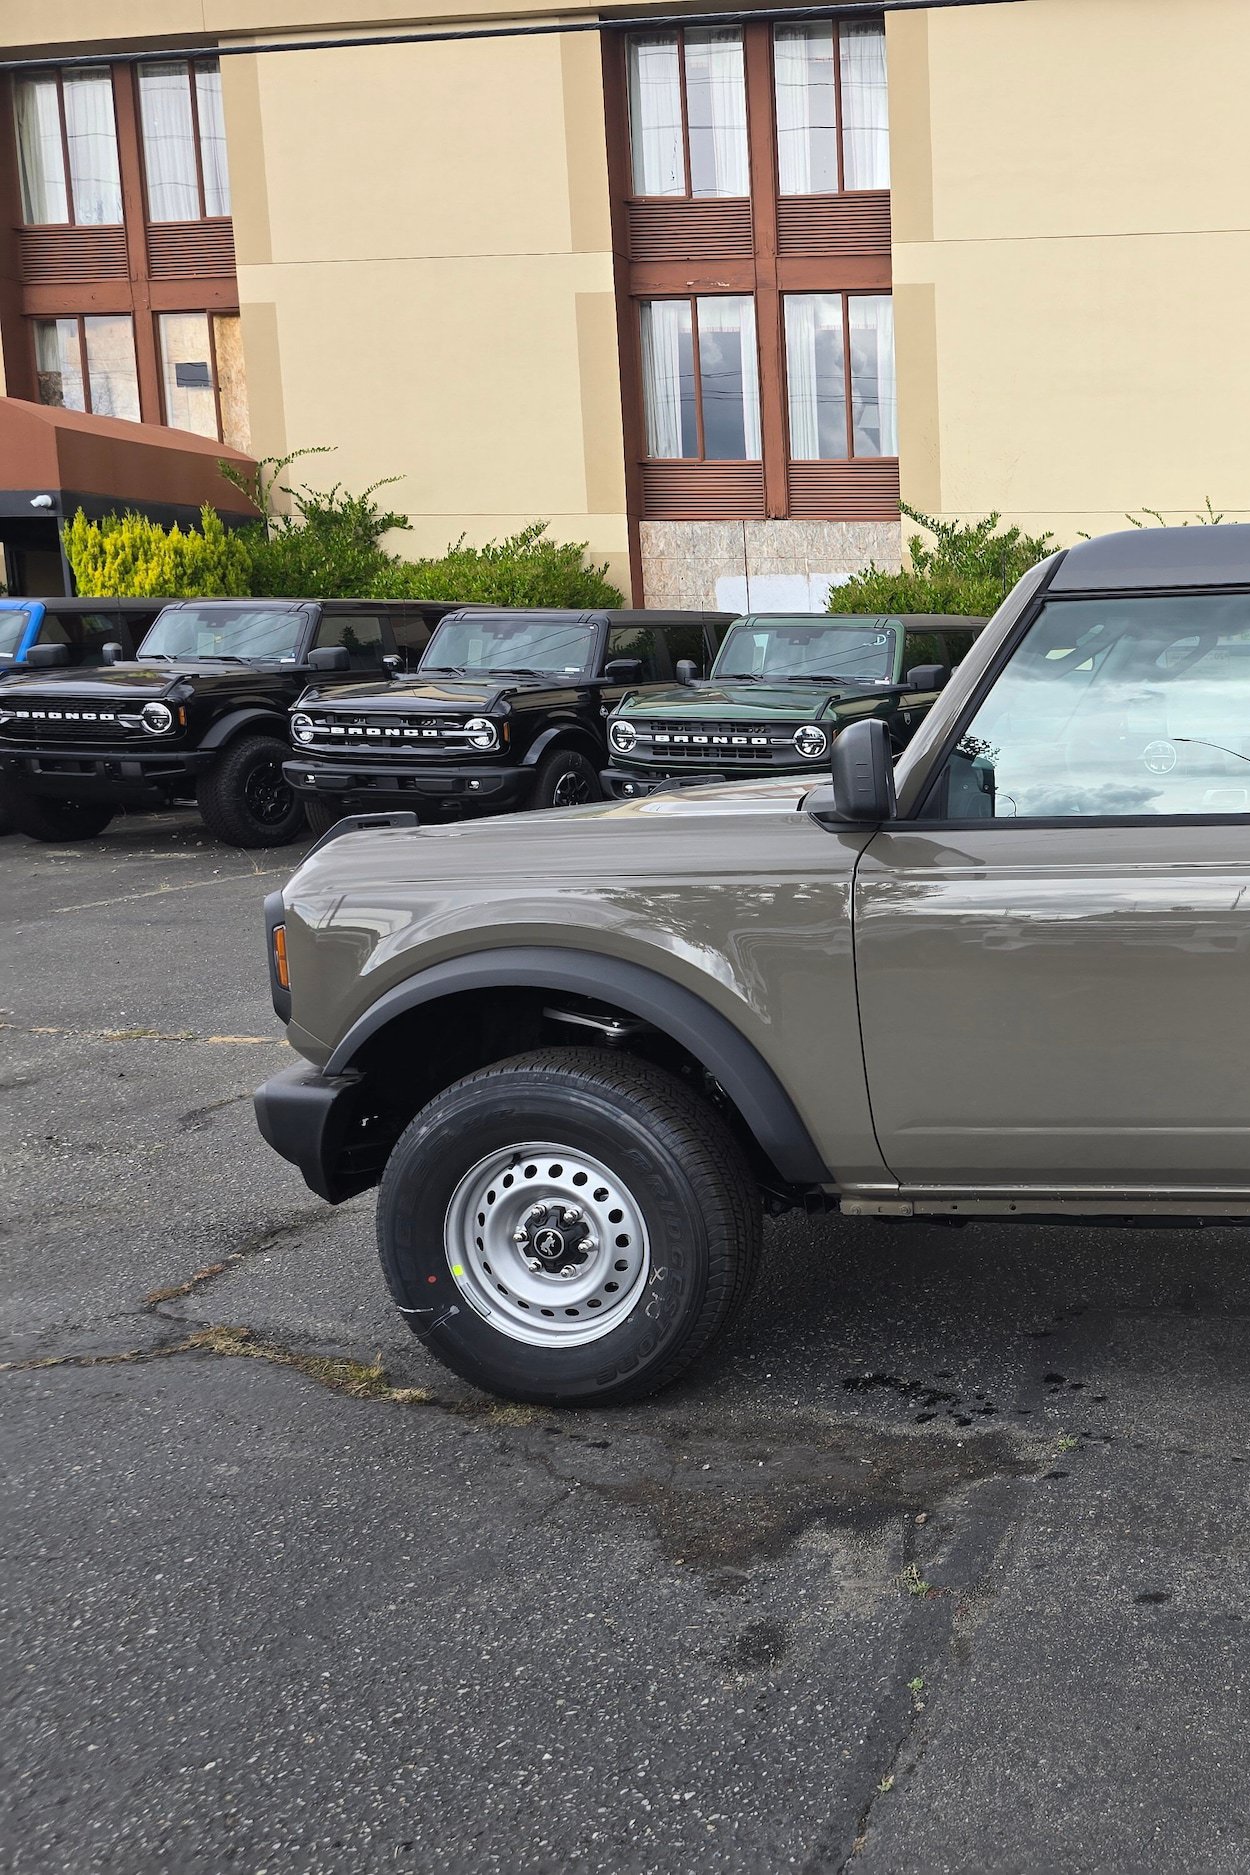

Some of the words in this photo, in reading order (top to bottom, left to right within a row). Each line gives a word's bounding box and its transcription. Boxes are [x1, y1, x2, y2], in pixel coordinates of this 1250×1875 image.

[16, 711, 115, 720] BRONCO
[330, 727, 438, 737] BRONCO
[655, 734, 767, 745] BRONCO
